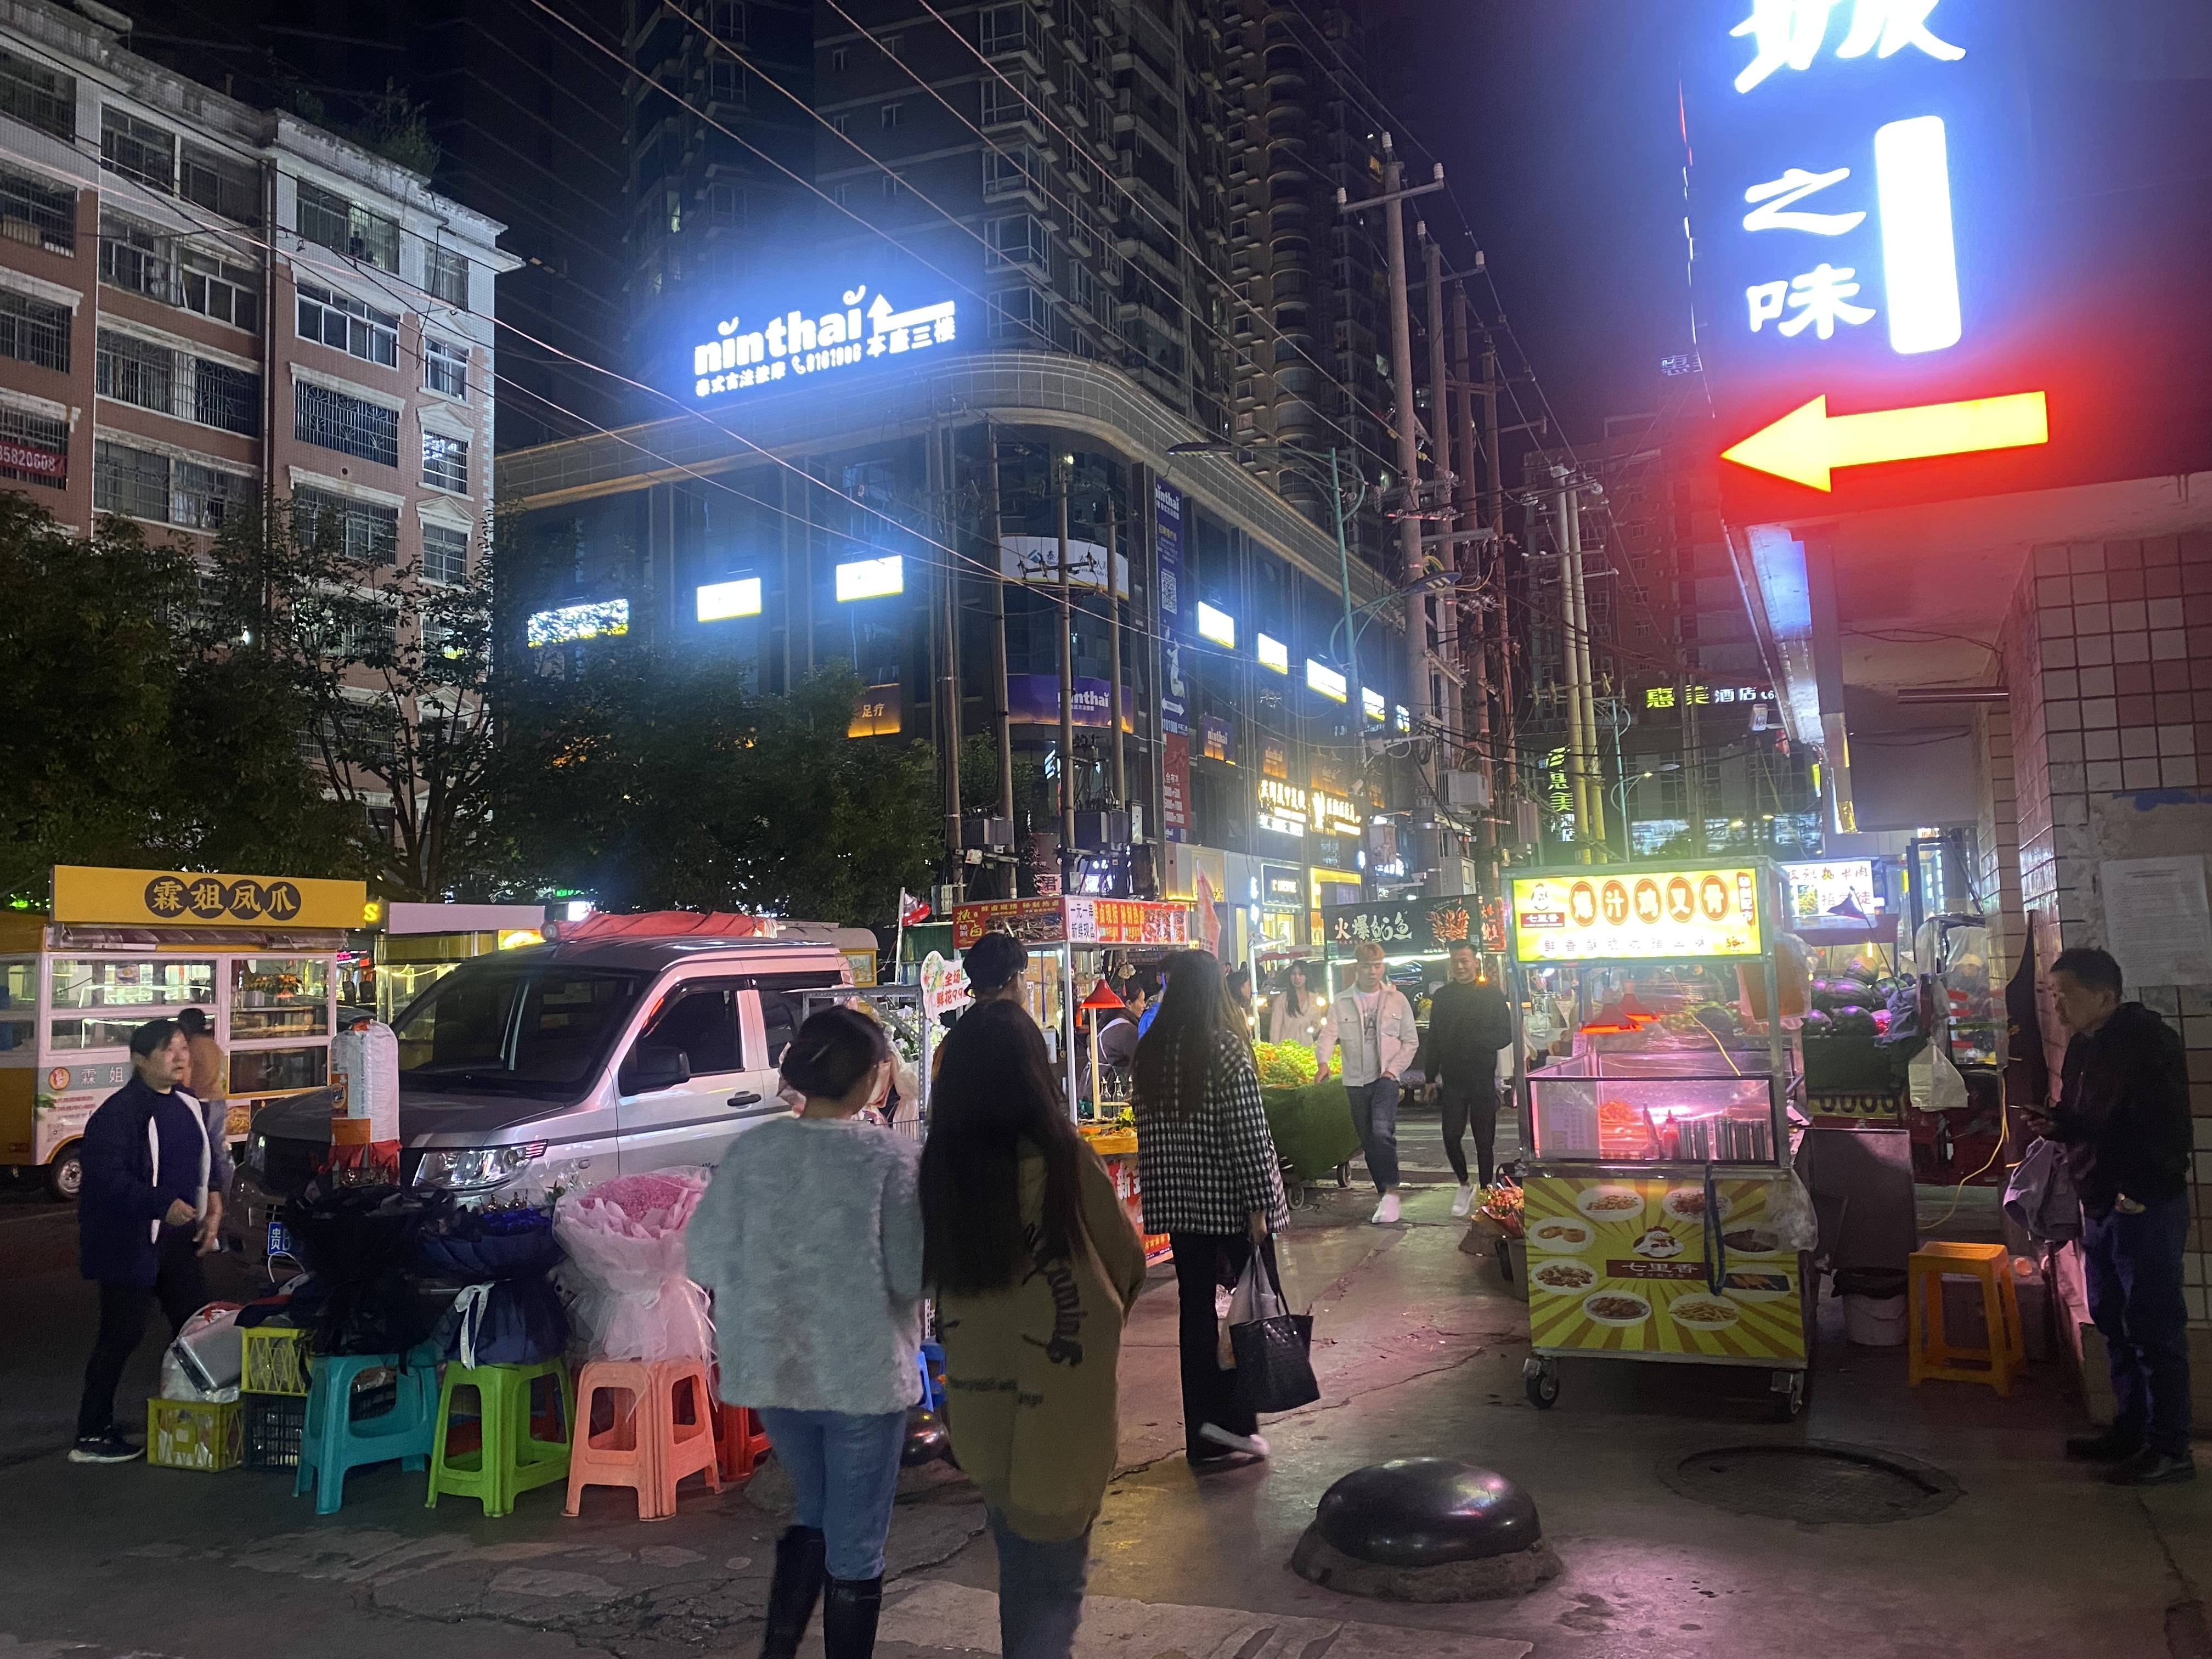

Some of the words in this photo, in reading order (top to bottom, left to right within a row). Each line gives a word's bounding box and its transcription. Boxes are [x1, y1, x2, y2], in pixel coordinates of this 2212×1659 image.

[1743, 167, 1876, 340] 之味
[1057, 687, 1109, 708] nthai
[862, 703, 884, 718] 足疗
[153, 883, 297, 912] 霖姐凤爪
[1335, 911, 1412, 941] 火爆鱿鱼
[1622, 1262, 1699, 1273] 七里香
